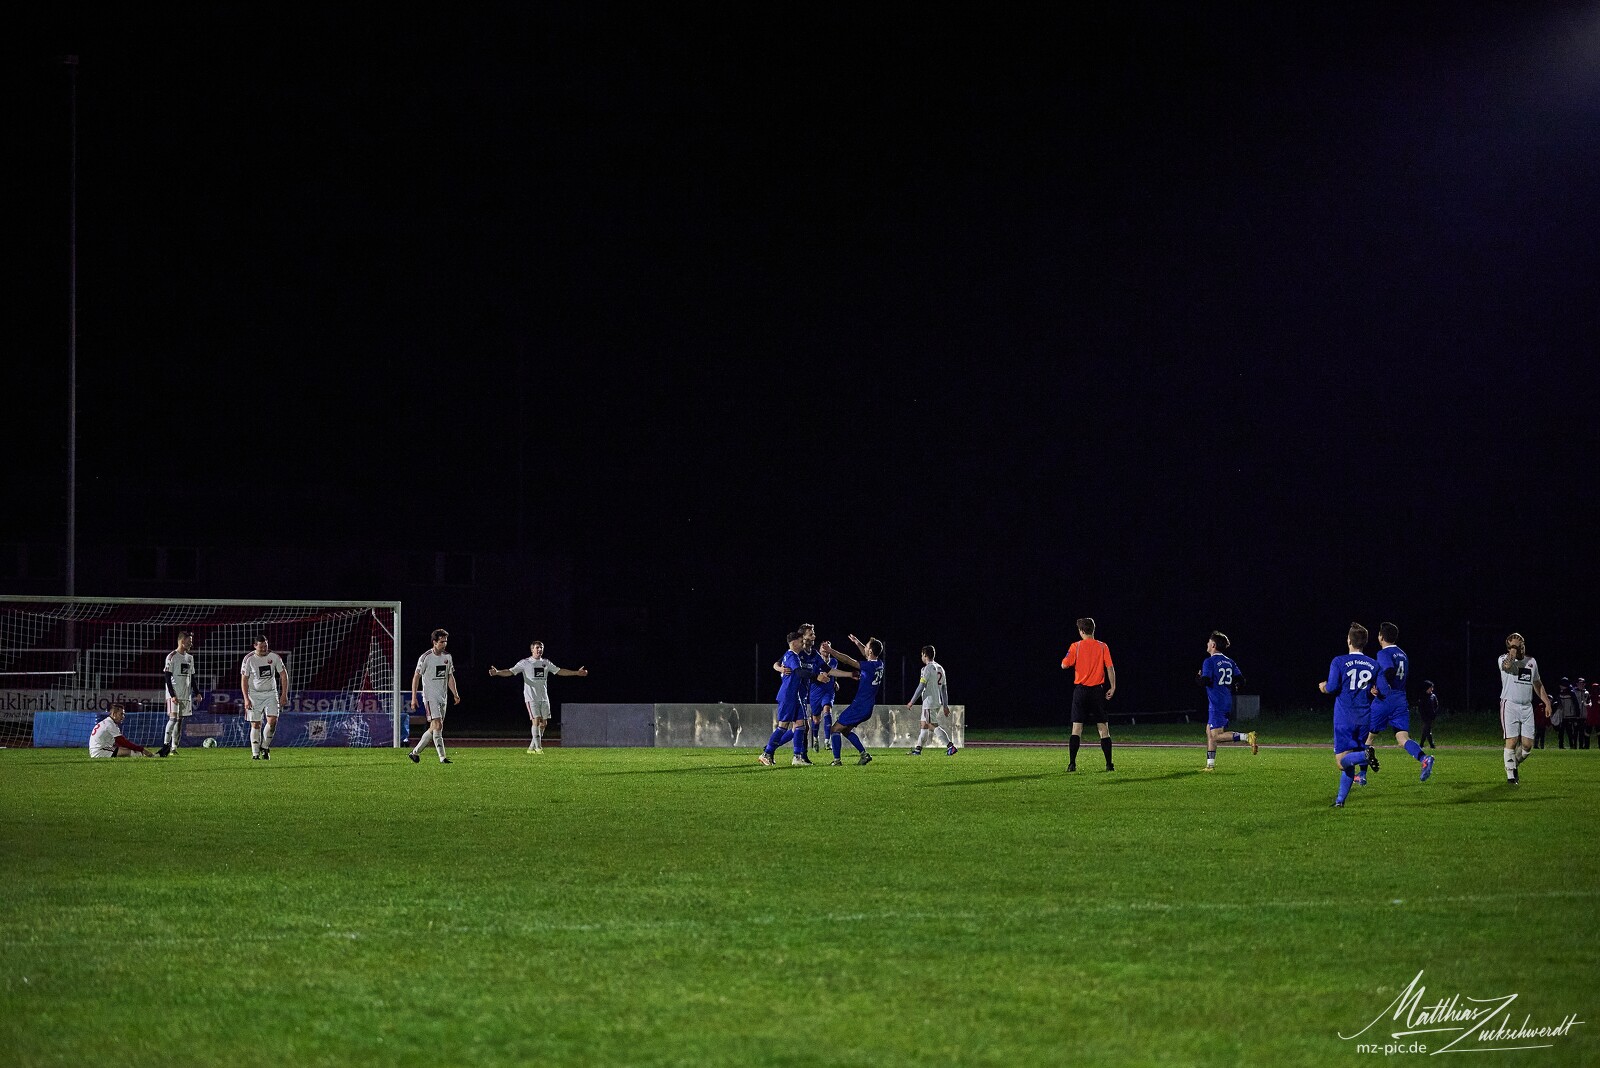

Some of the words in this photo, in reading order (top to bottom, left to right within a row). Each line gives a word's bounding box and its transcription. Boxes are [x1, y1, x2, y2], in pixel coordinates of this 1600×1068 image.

[937, 672, 943, 686] 2
[1218, 667, 1233, 686] 23
[1346, 668, 1372, 690] 18
[1395, 660, 1405, 680] 4
[91, 723, 101, 737] 3
